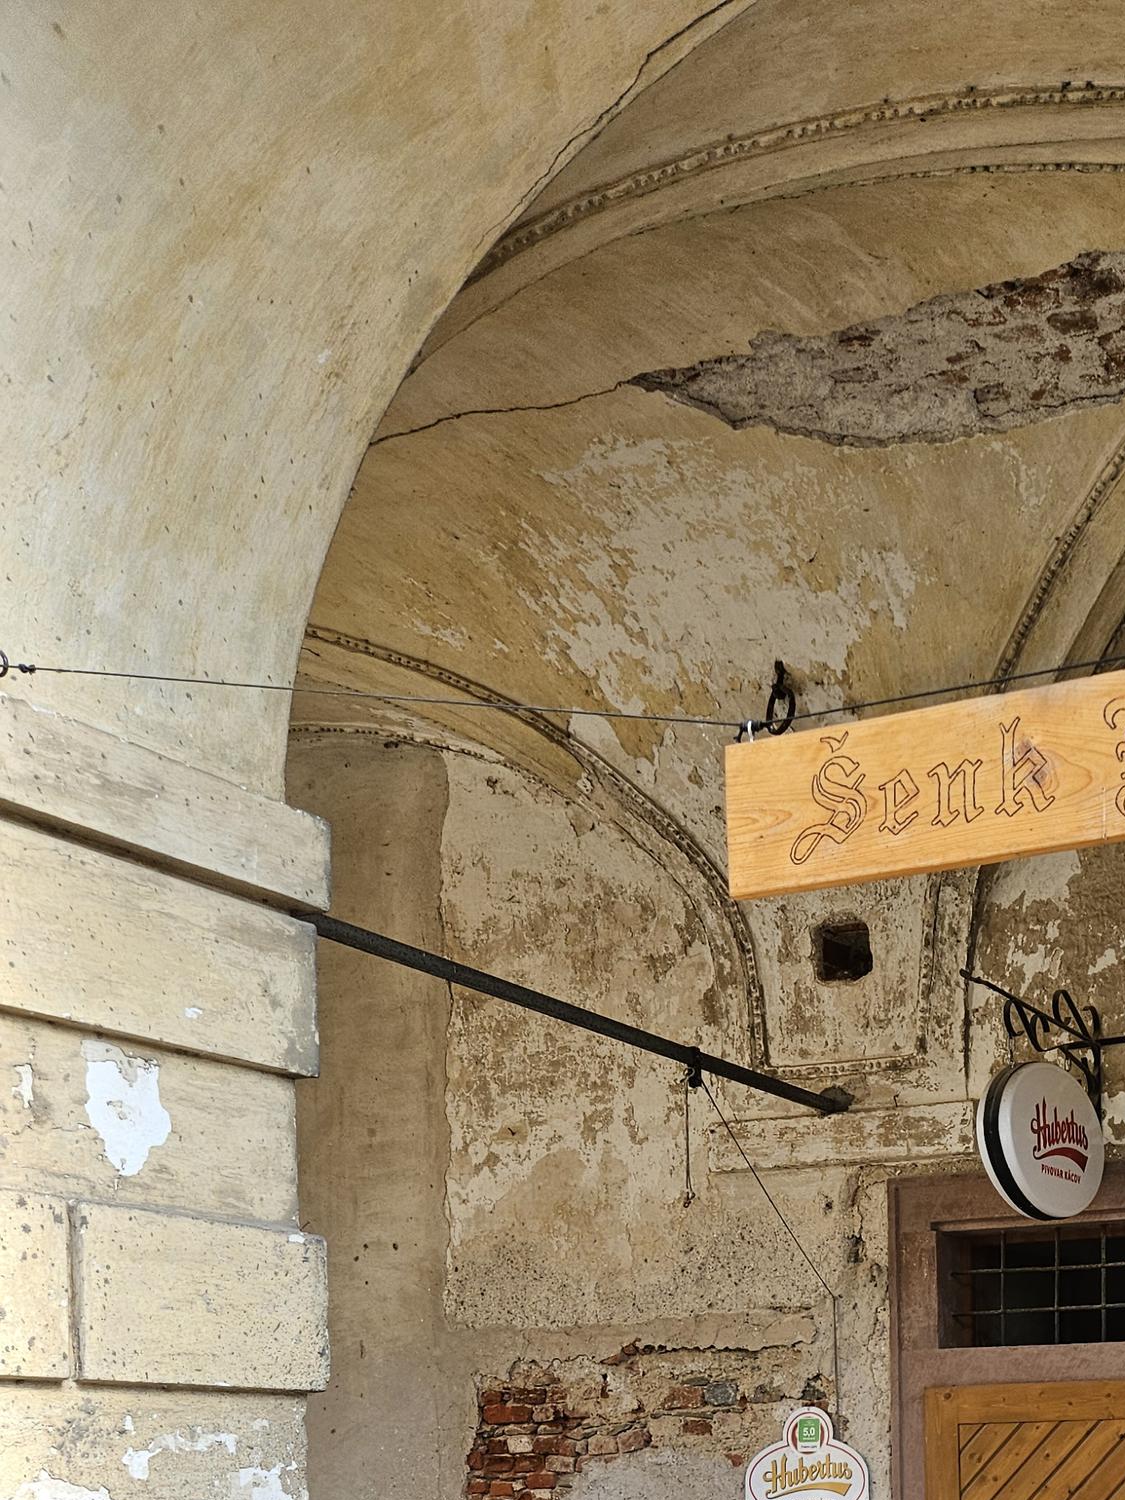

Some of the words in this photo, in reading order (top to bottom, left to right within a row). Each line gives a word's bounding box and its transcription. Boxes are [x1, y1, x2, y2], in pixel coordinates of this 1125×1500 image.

[789, 717, 1057, 865] Šenk
[1030, 1096, 1089, 1152] Hubertus
[1041, 1163, 1064, 1179] PIVOVAR
[1064, 1168, 1082, 1184] KÁCOV
[762, 1453, 853, 1494] Hubertus
